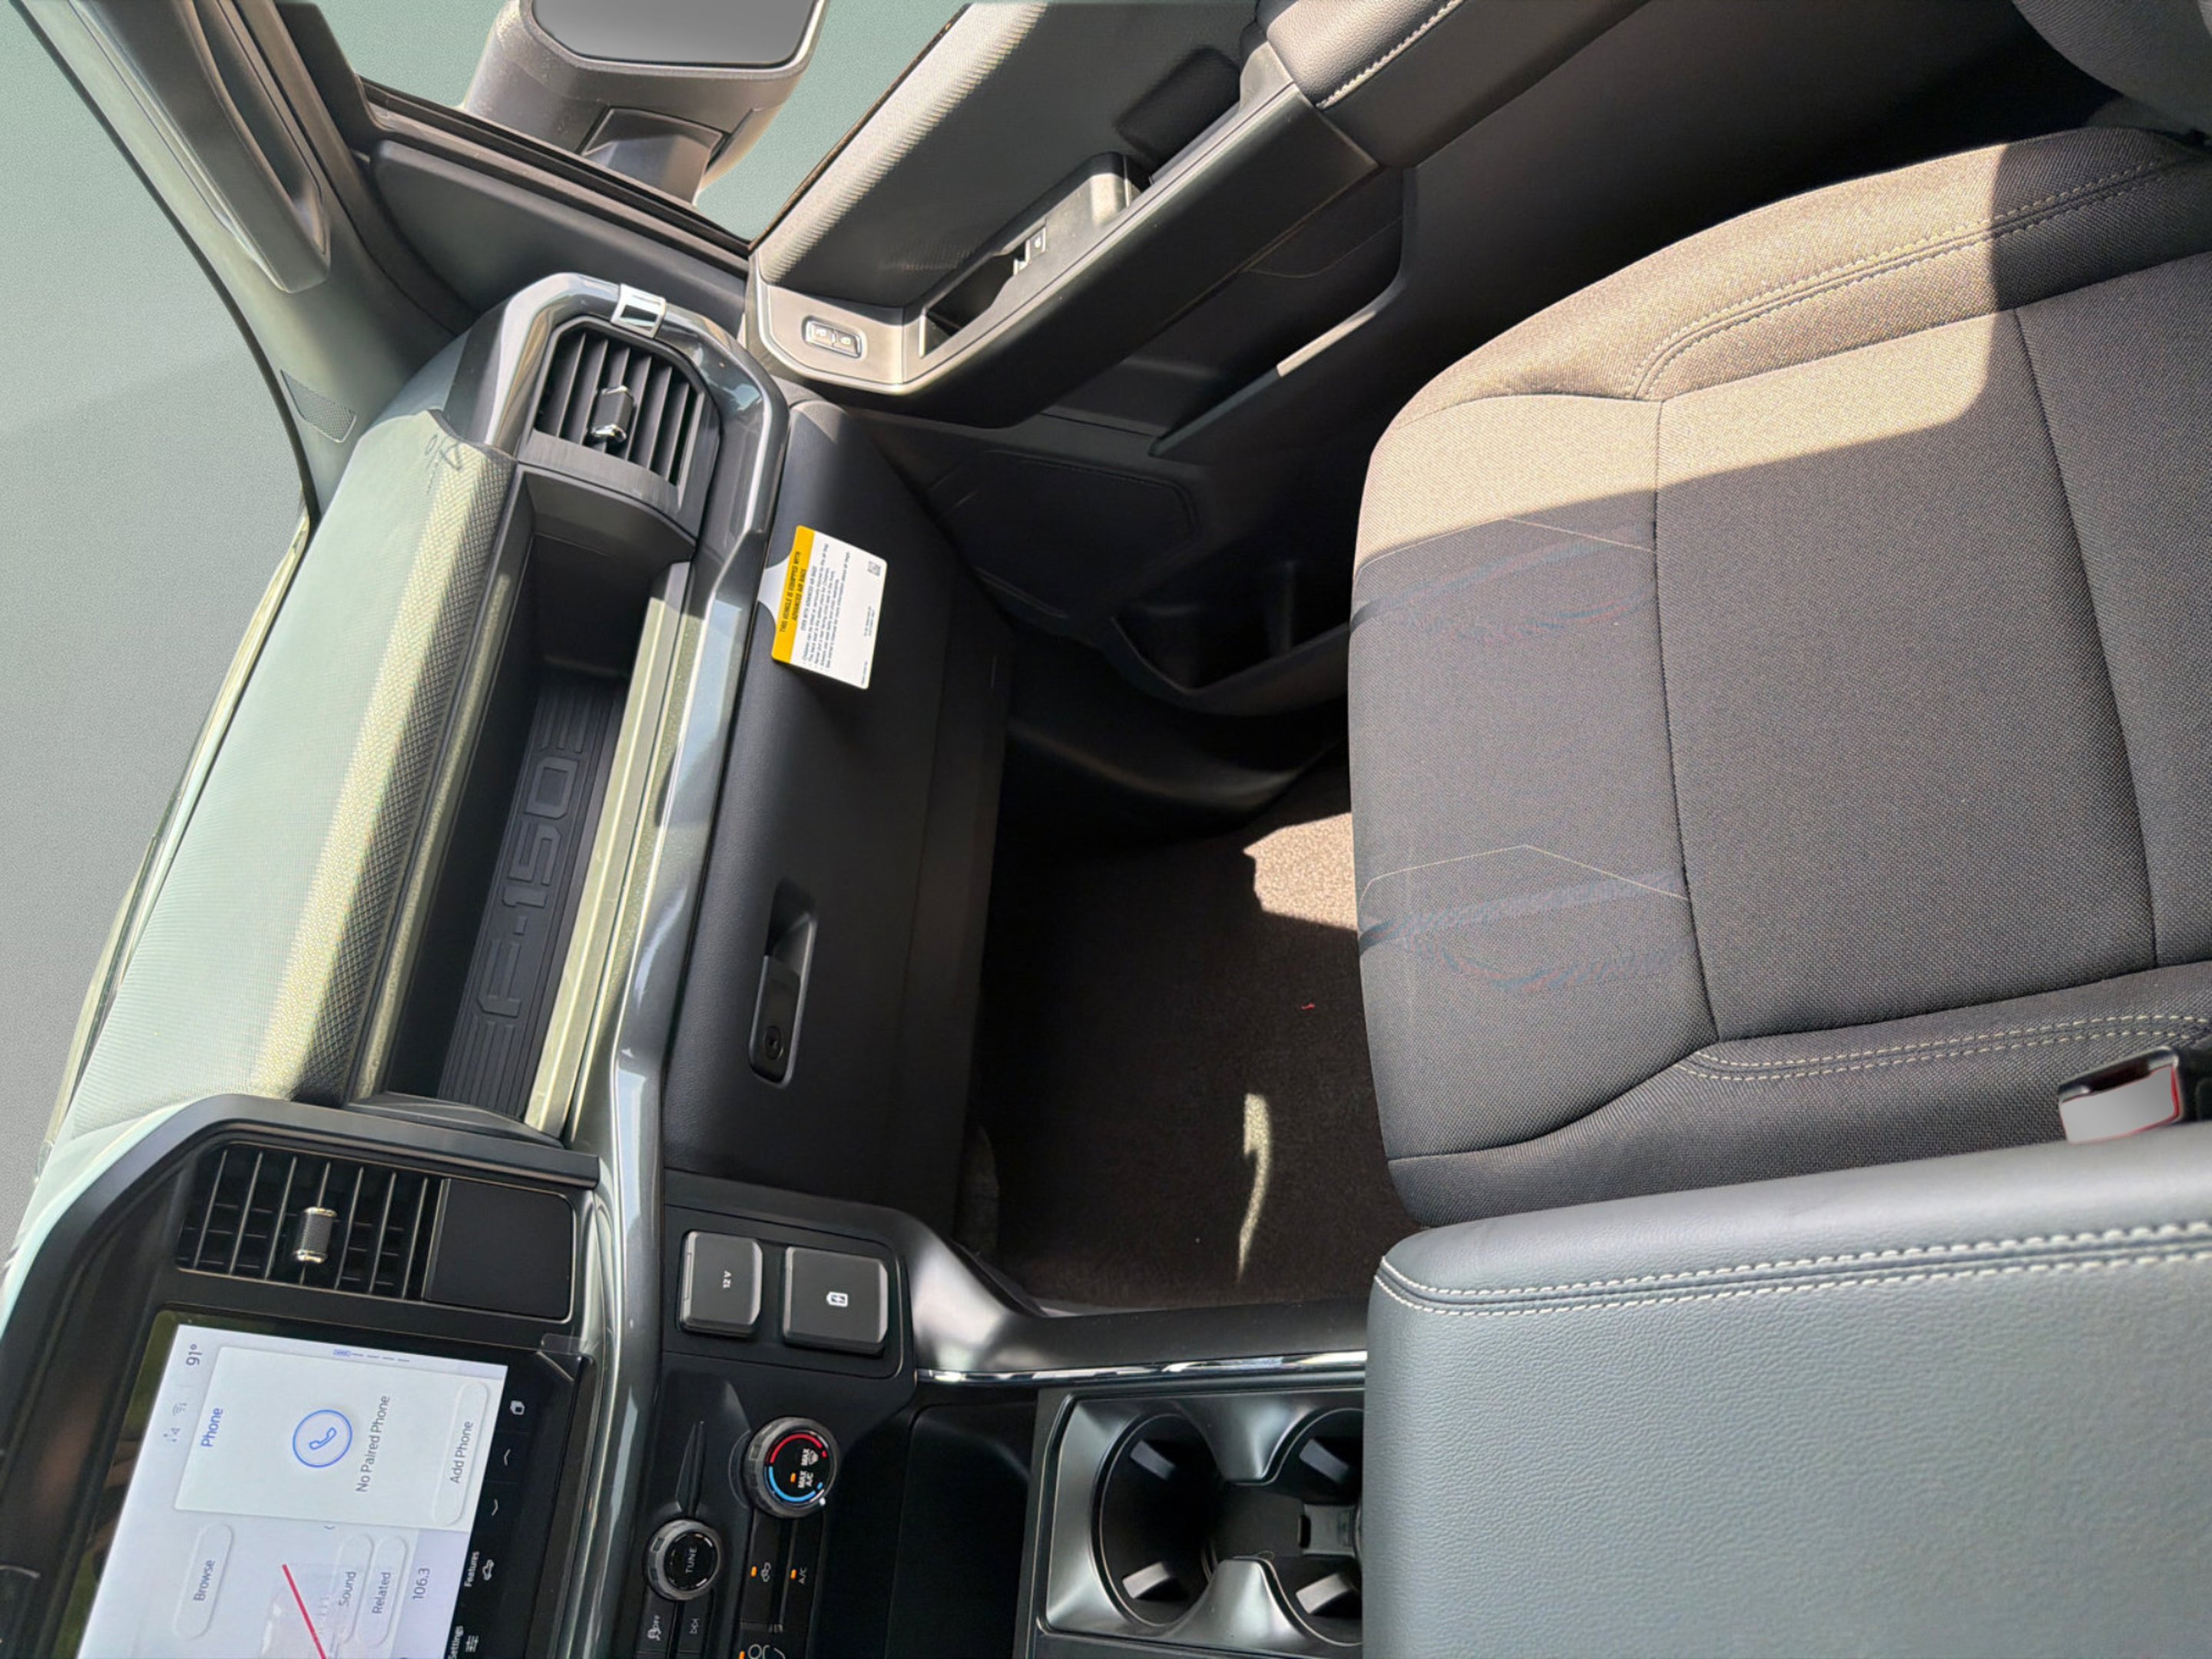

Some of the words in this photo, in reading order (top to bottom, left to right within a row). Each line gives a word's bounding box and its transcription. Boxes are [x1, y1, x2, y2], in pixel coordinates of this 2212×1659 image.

[478, 757, 580, 1018] F-150
[186, 1343, 203, 1366] 91°
[200, 1407, 224, 1447] Phone
[370, 1396, 390, 1433] Phone
[360, 1435, 381, 1473] Paired
[454, 1421, 473, 1459] Phone
[800, 1448, 810, 1466] MAX
[356, 1475, 371, 1492] No
[449, 1459, 465, 1484] Add
[797, 1470, 807, 1488] MAX
[806, 1472, 814, 1488] A/C
[464, 1551, 480, 1587] Features
[685, 1547, 697, 1574] TUNE
[798, 1567, 807, 1584] A/C
[193, 1559, 216, 1601] Browse
[339, 1571, 356, 1607] Sound
[372, 1571, 392, 1614] Related
[412, 1568, 430, 1600] 106.3
